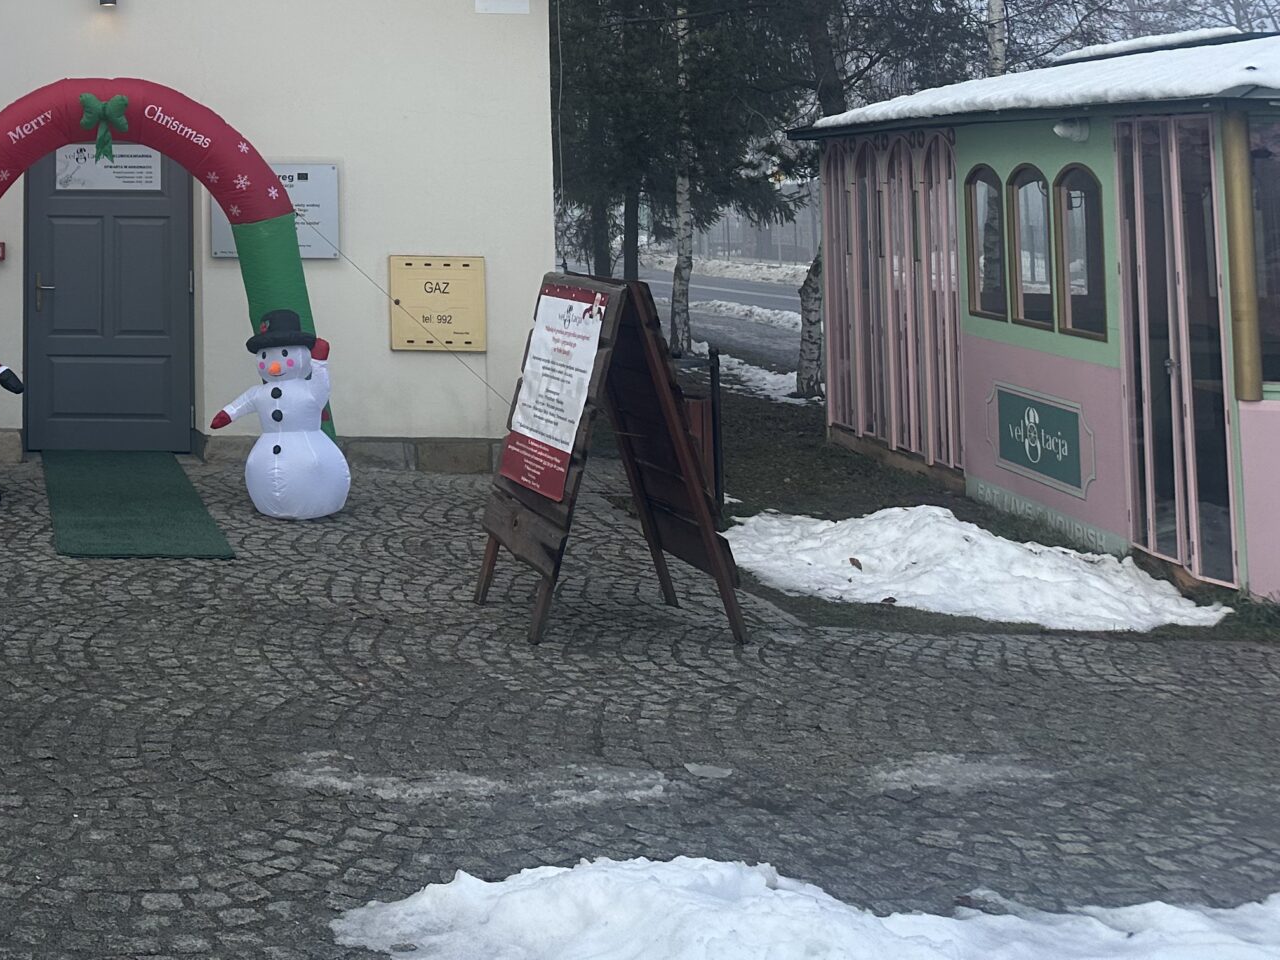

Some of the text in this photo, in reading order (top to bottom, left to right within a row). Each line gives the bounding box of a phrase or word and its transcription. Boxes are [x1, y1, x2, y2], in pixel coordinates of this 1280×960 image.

[7, 105, 212, 148] Merry Christmas
[423, 281, 450, 294] GAZ
[436, 314, 453, 325] 992
[977, 484, 1000, 507] EAT
